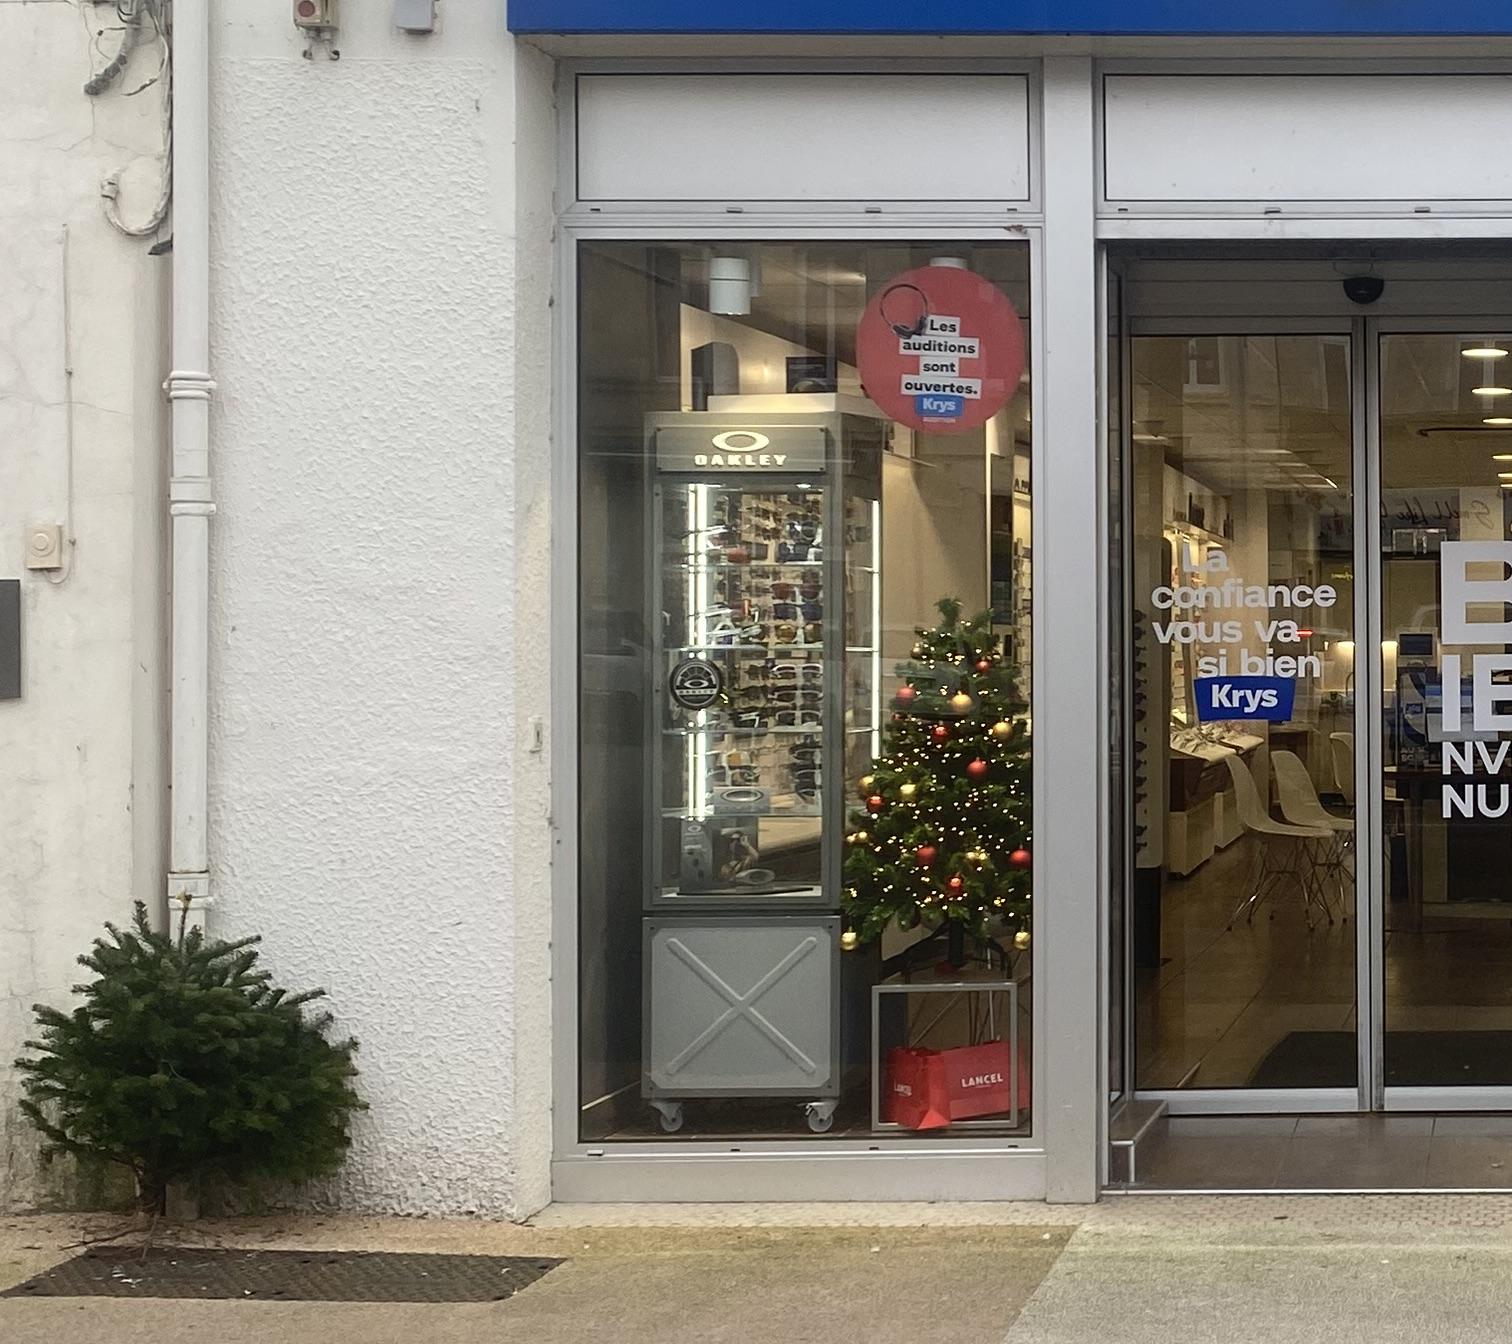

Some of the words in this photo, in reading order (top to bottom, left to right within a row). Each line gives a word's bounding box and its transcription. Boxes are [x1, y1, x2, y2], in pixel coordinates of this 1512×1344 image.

[929, 319, 957, 333] Les
[902, 340, 976, 354] auditions
[923, 362, 956, 373] sont
[904, 381, 978, 395] ouvertes.
[923, 398, 956, 413] Krys
[694, 454, 787, 466] OAKLEY
[1182, 542, 1230, 573] La
[1151, 577, 1337, 609] confiance
[1151, 619, 1243, 644] vous
[1254, 618, 1301, 643] va
[1198, 649, 1227, 679] si
[1240, 648, 1321, 678] bien
[1211, 684, 1279, 713] Krys
[961, 1073, 1004, 1088] LANCEL
